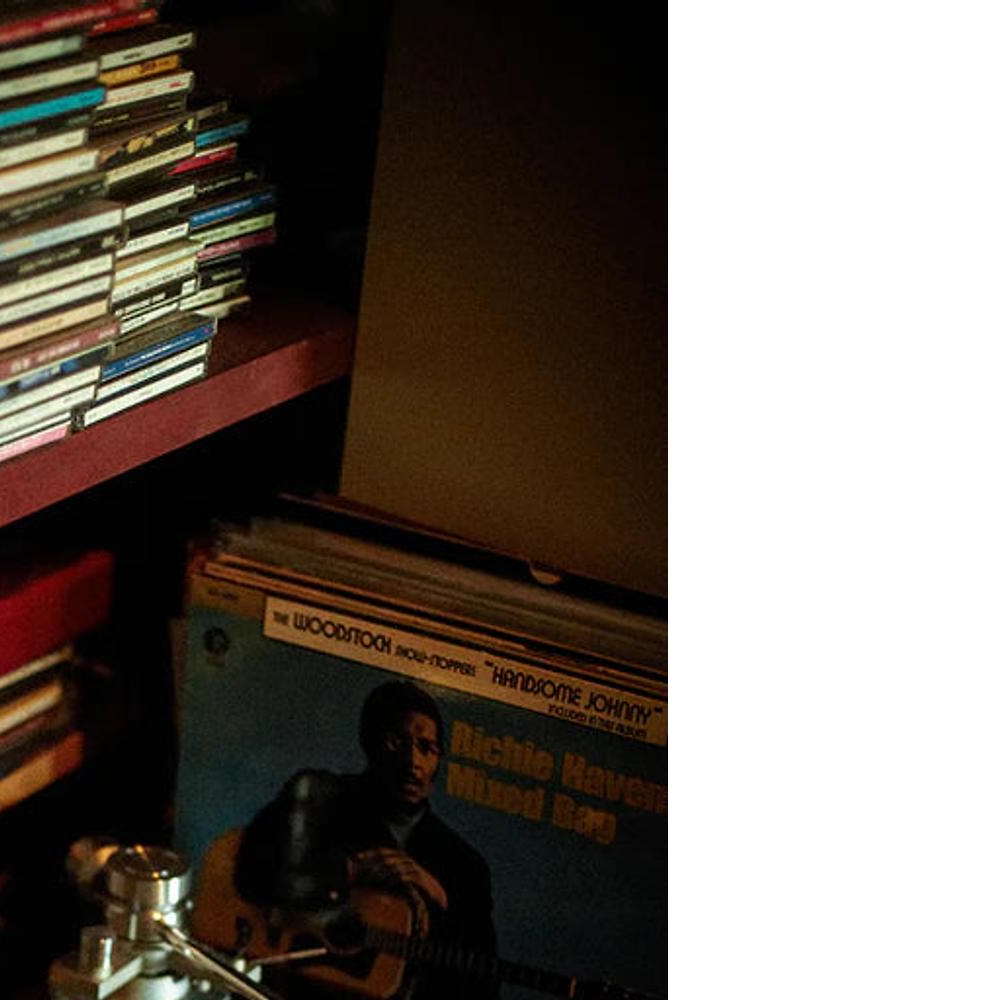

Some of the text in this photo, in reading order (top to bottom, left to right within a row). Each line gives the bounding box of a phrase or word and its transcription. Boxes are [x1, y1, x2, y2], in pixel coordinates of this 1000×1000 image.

[293, 612, 391, 654] WOODSTOCK
[451, 720, 554, 781] Richie
[446, 762, 617, 845] Mixed Bag
